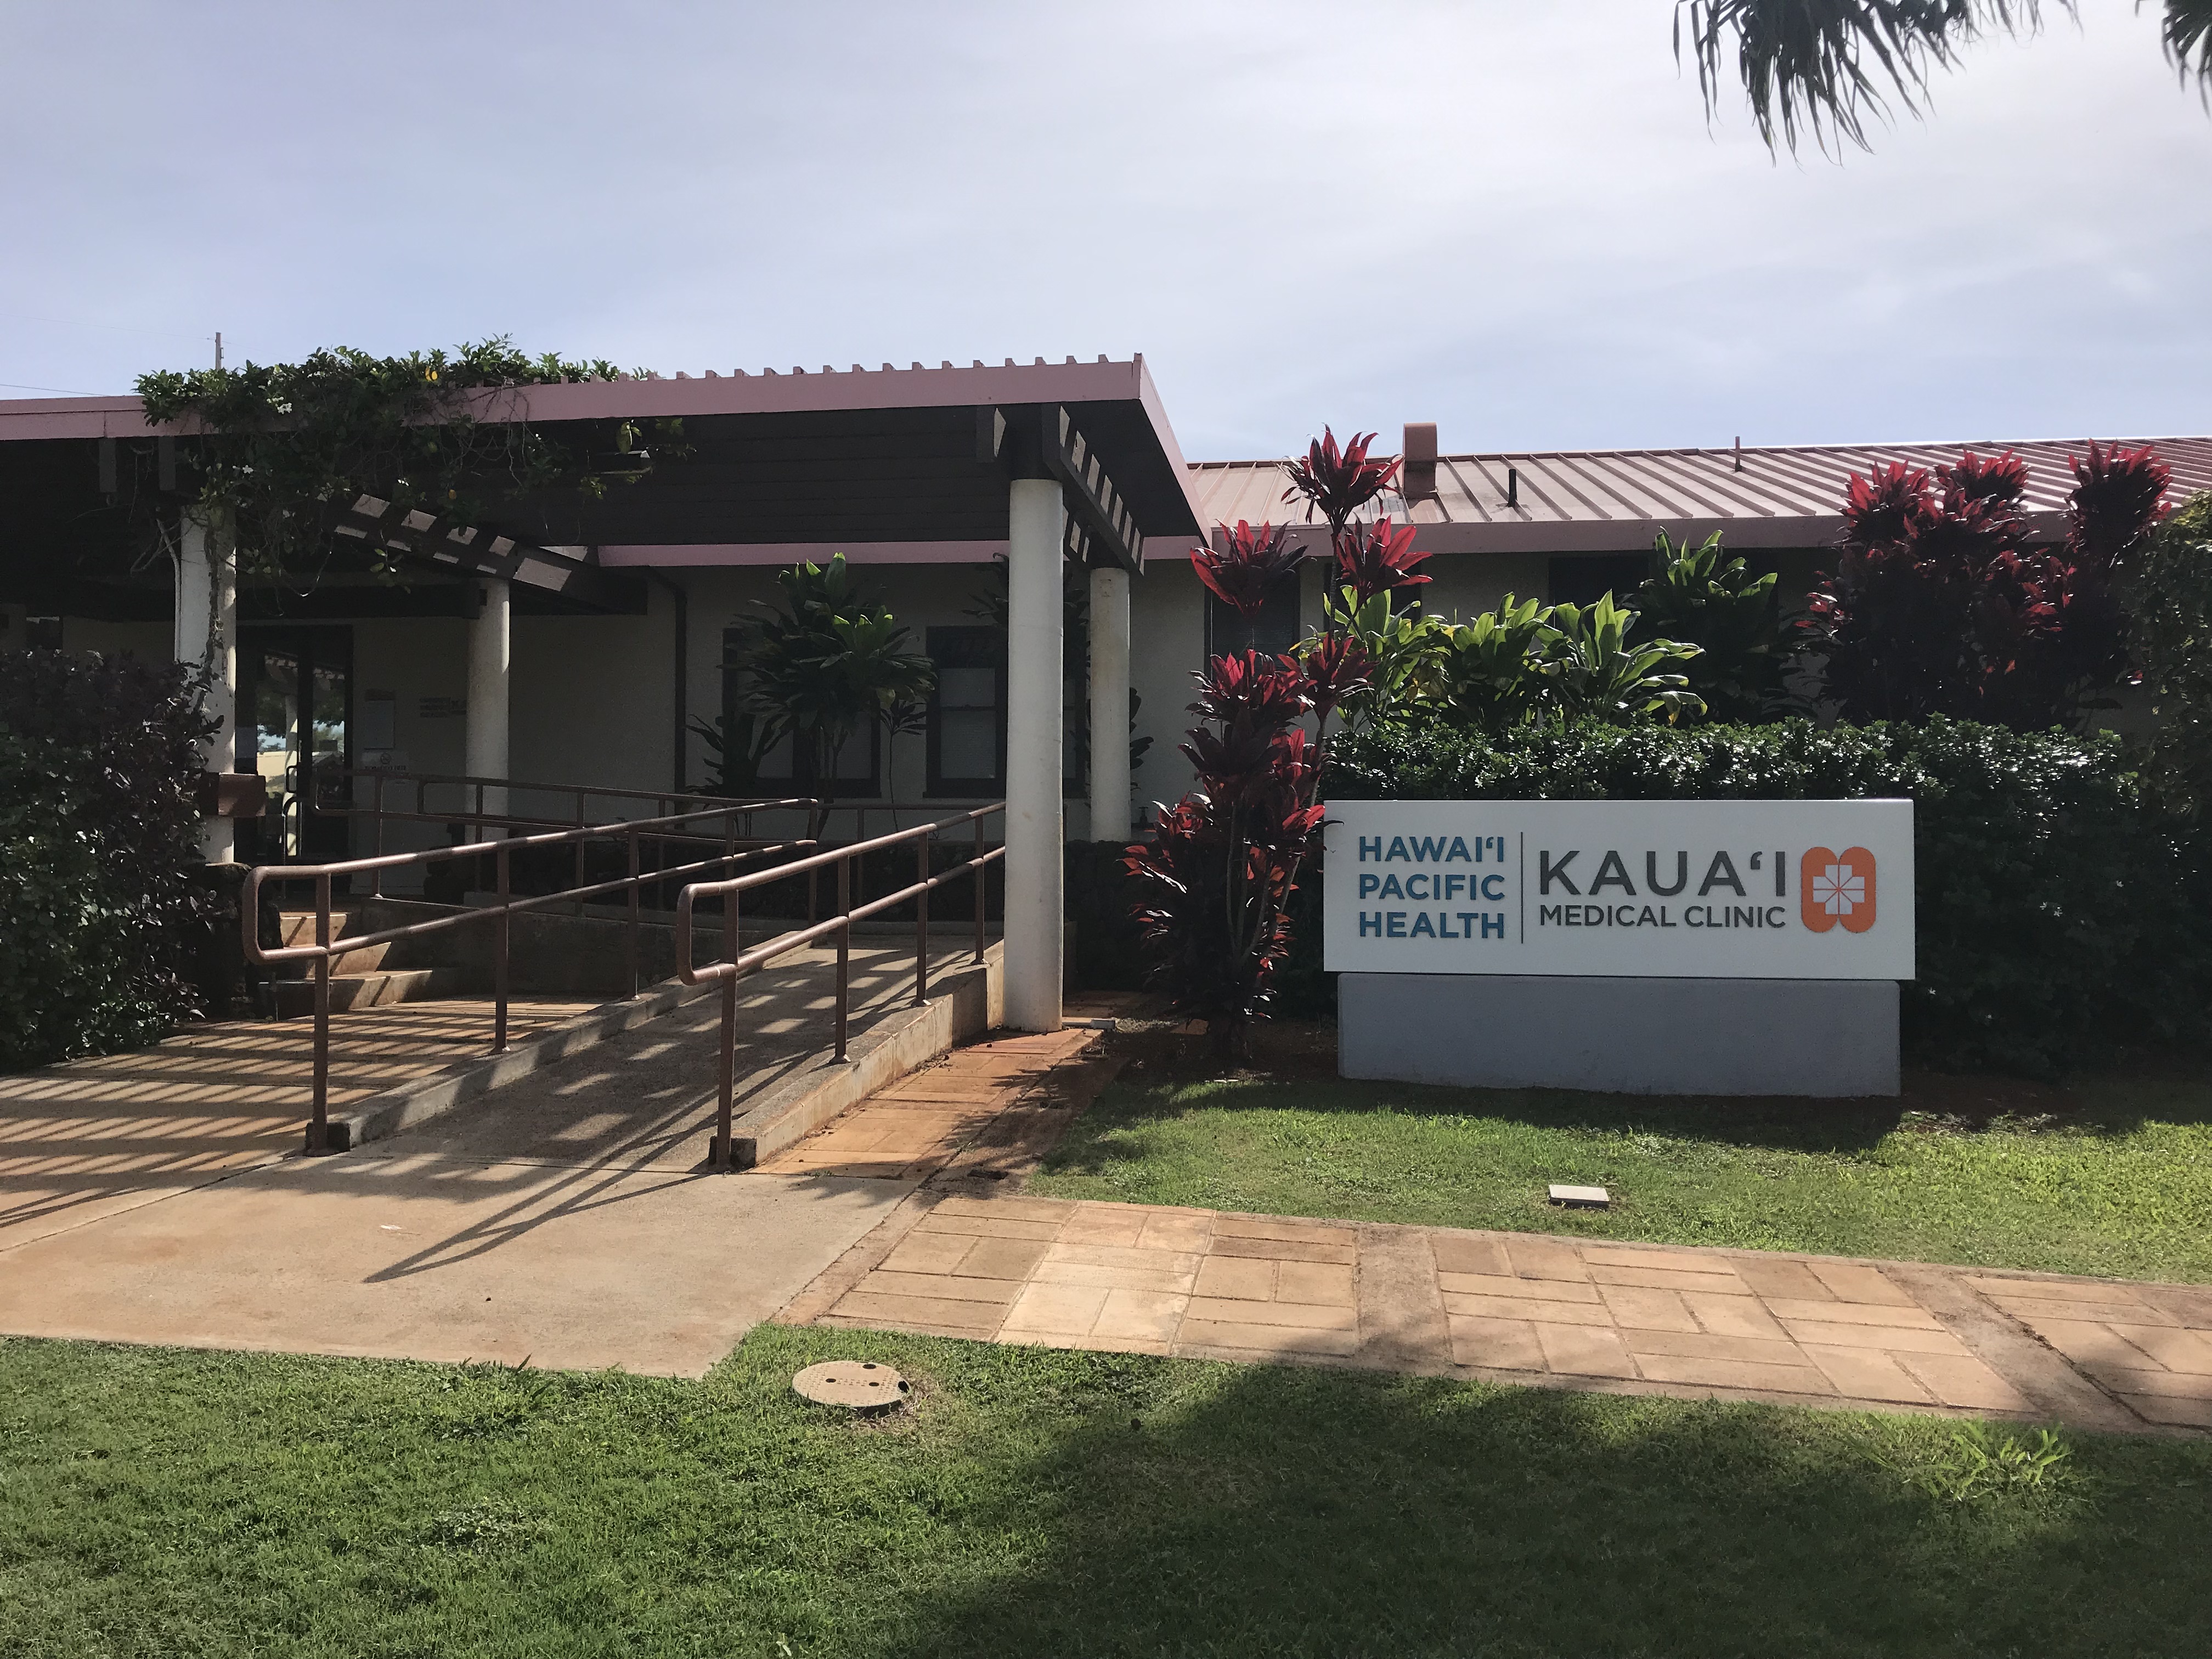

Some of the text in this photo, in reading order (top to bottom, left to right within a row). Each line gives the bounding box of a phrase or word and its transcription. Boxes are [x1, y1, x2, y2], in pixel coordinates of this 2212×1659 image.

[1358, 873, 1505, 901] PACIFIC
[1359, 911, 1505, 940] HEALTH
[1539, 904, 1786, 929] MEDICAL CLINIC
